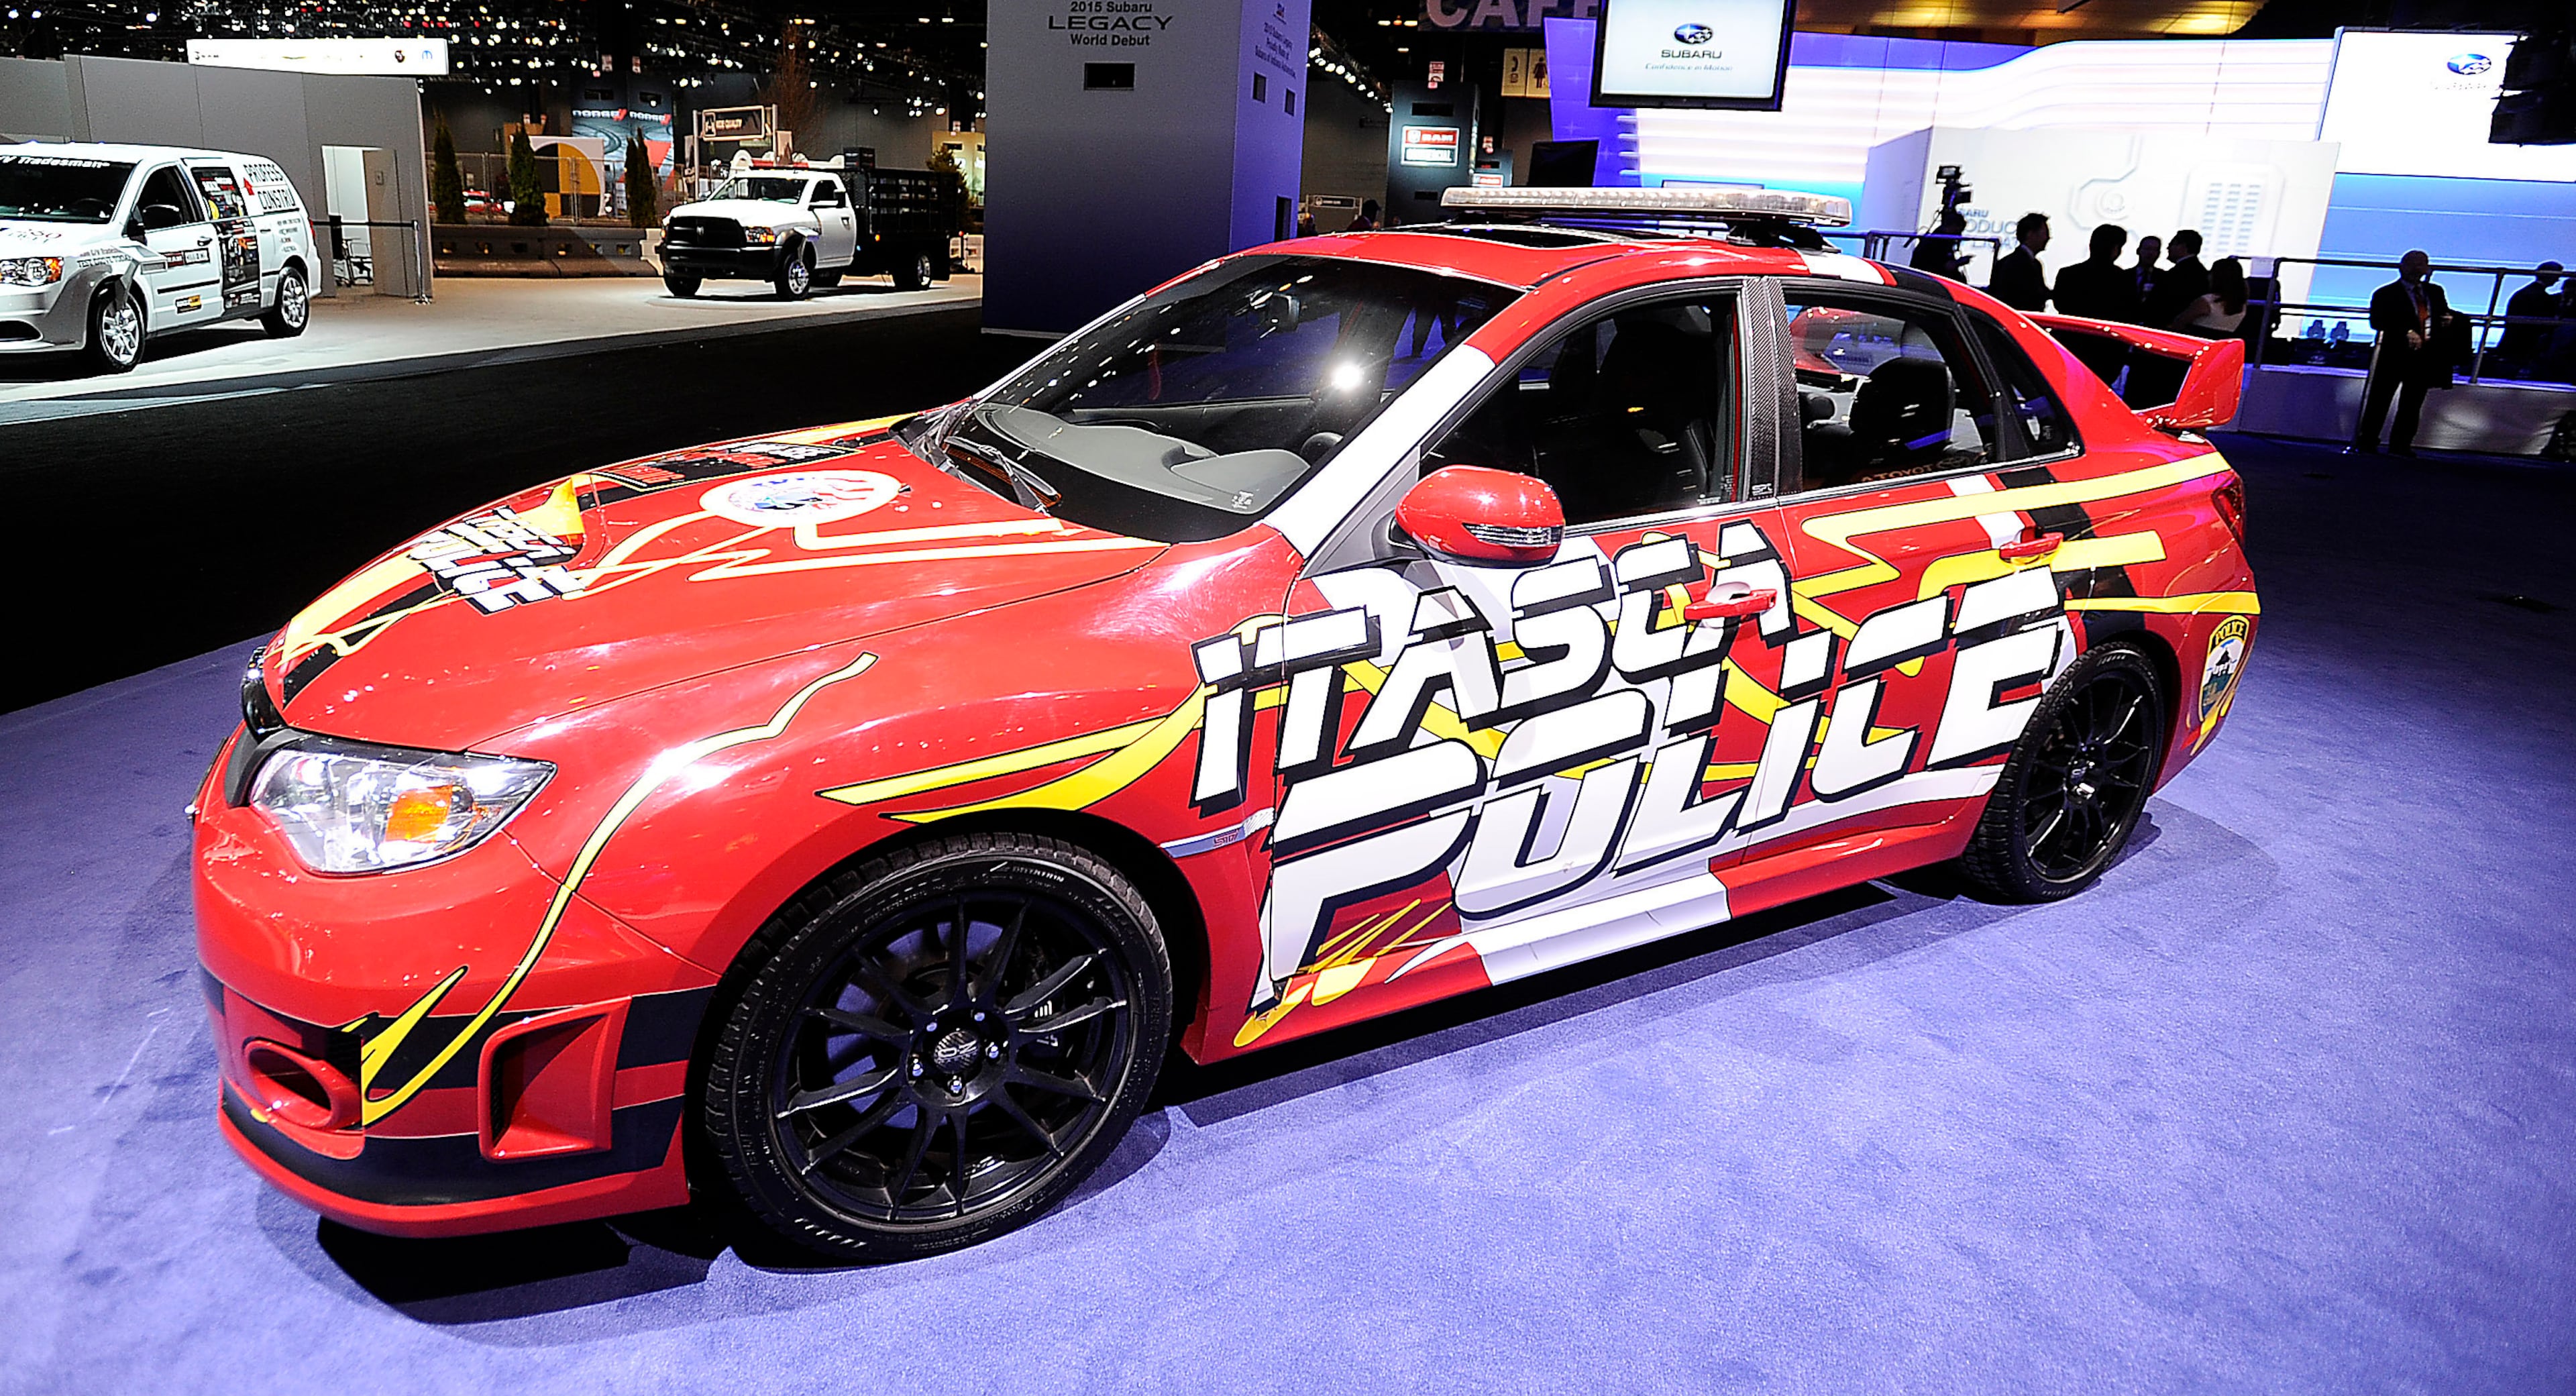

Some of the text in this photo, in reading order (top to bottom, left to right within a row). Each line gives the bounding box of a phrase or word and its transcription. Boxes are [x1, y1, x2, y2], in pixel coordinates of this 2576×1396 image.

[1071, 1, 1152, 12] 2015 Subaru
[1048, 15, 1174, 30] LEGACY
[1071, 34, 1150, 46] World Debut
[1661, 49, 1722, 59] SUBARU
[1421, 133, 1454, 142] RAM
[2215, 622, 2245, 645] POLICE
[1270, 565, 2063, 983] POLICE
